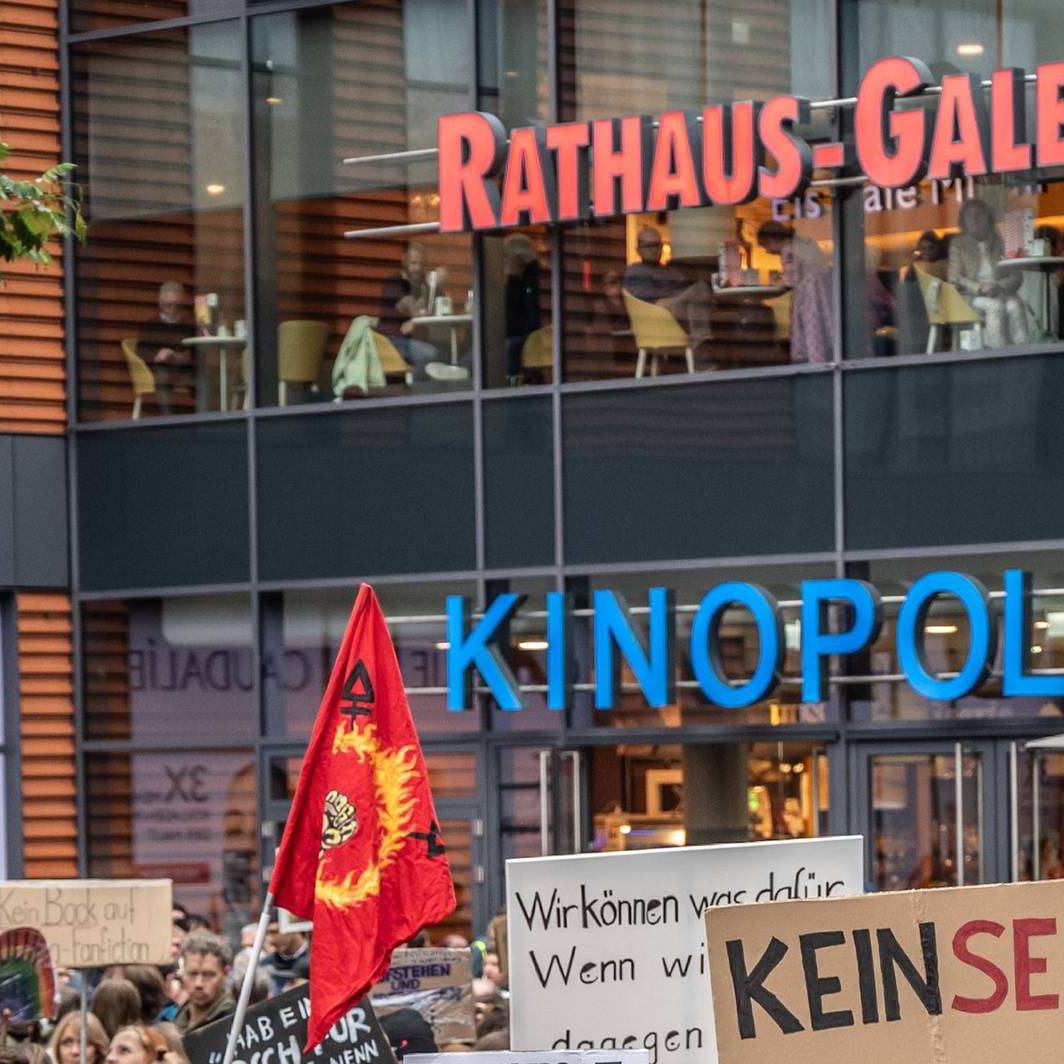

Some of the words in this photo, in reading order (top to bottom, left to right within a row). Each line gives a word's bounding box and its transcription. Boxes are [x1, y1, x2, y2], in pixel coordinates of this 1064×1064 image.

[446, 569, 1064, 711] KINOPOL
[529, 946, 635, 988] Wenn
[662, 942, 705, 978] wi
[726, 921, 943, 1040] KEIN
